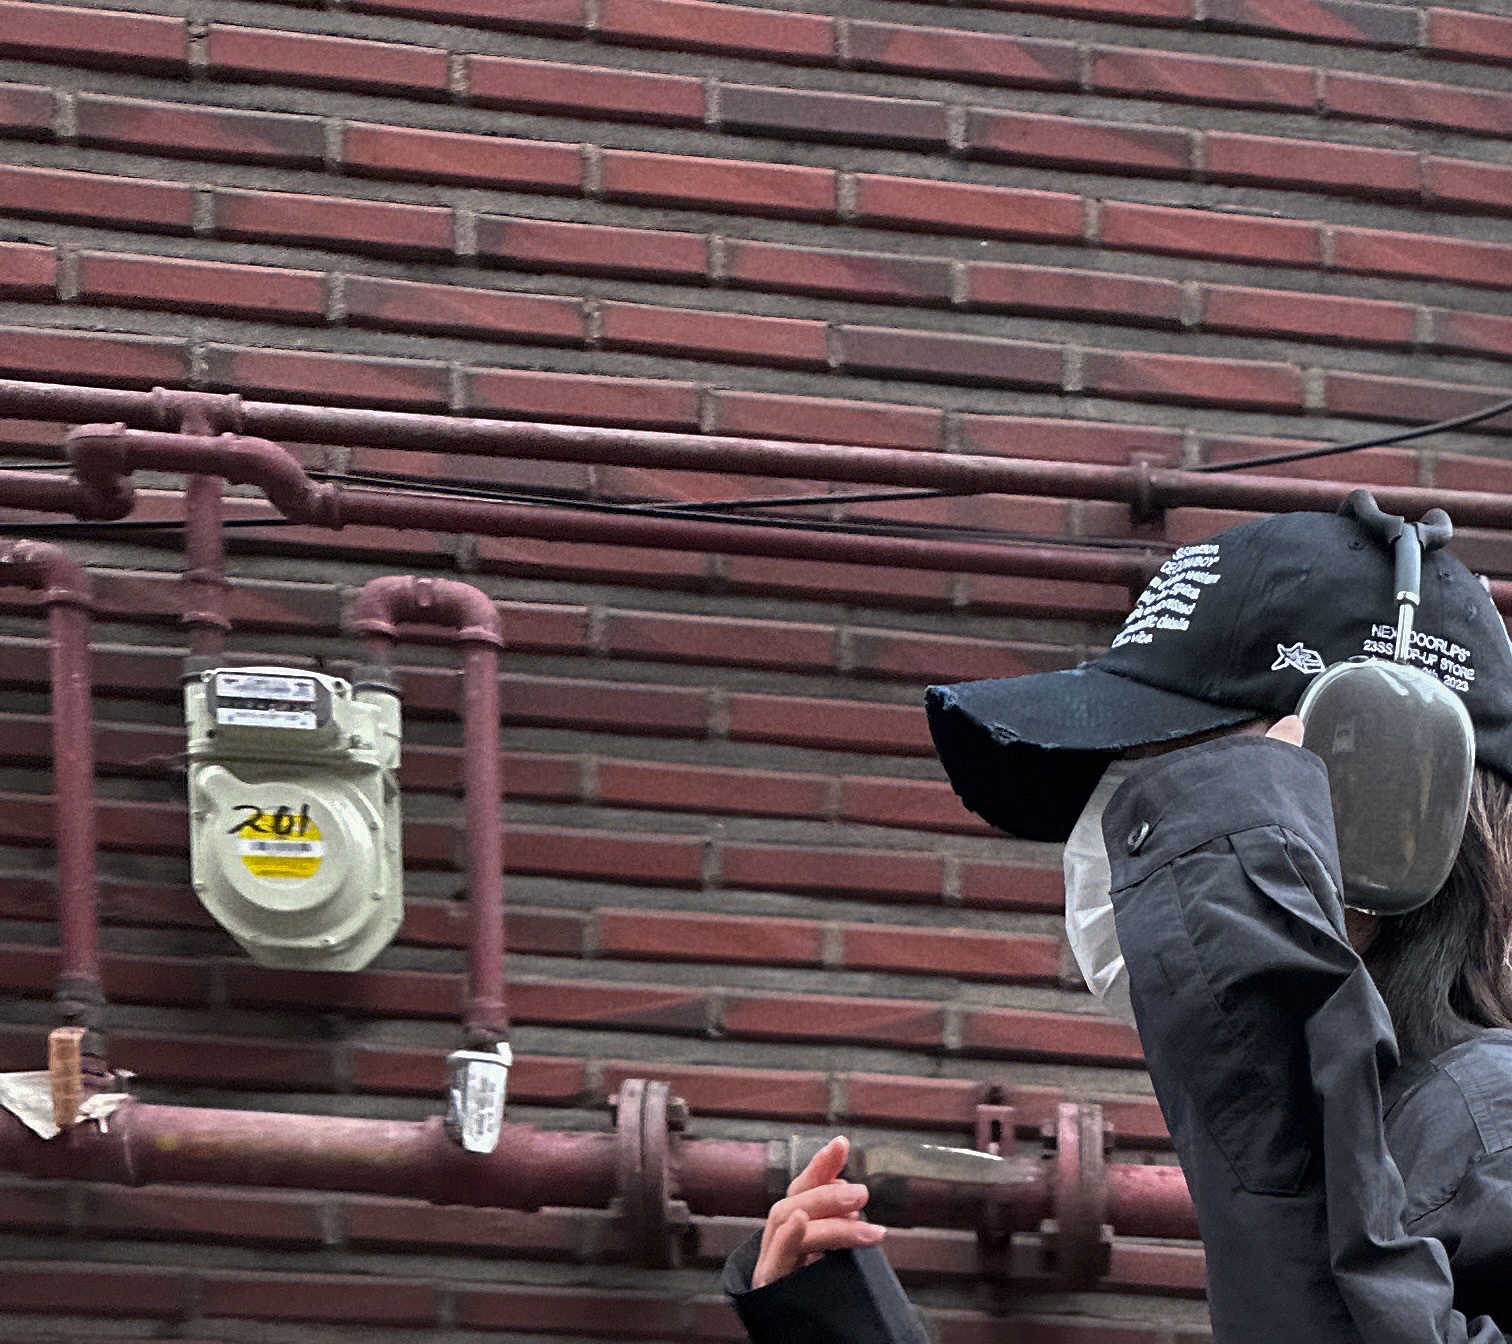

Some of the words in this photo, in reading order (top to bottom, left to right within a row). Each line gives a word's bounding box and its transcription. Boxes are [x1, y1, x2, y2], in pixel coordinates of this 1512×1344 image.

[1362, 639, 1394, 656] 23SS
[1440, 657, 1476, 681] STORE
[1443, 674, 1470, 693] 2023
[228, 803, 311, 837] 201
